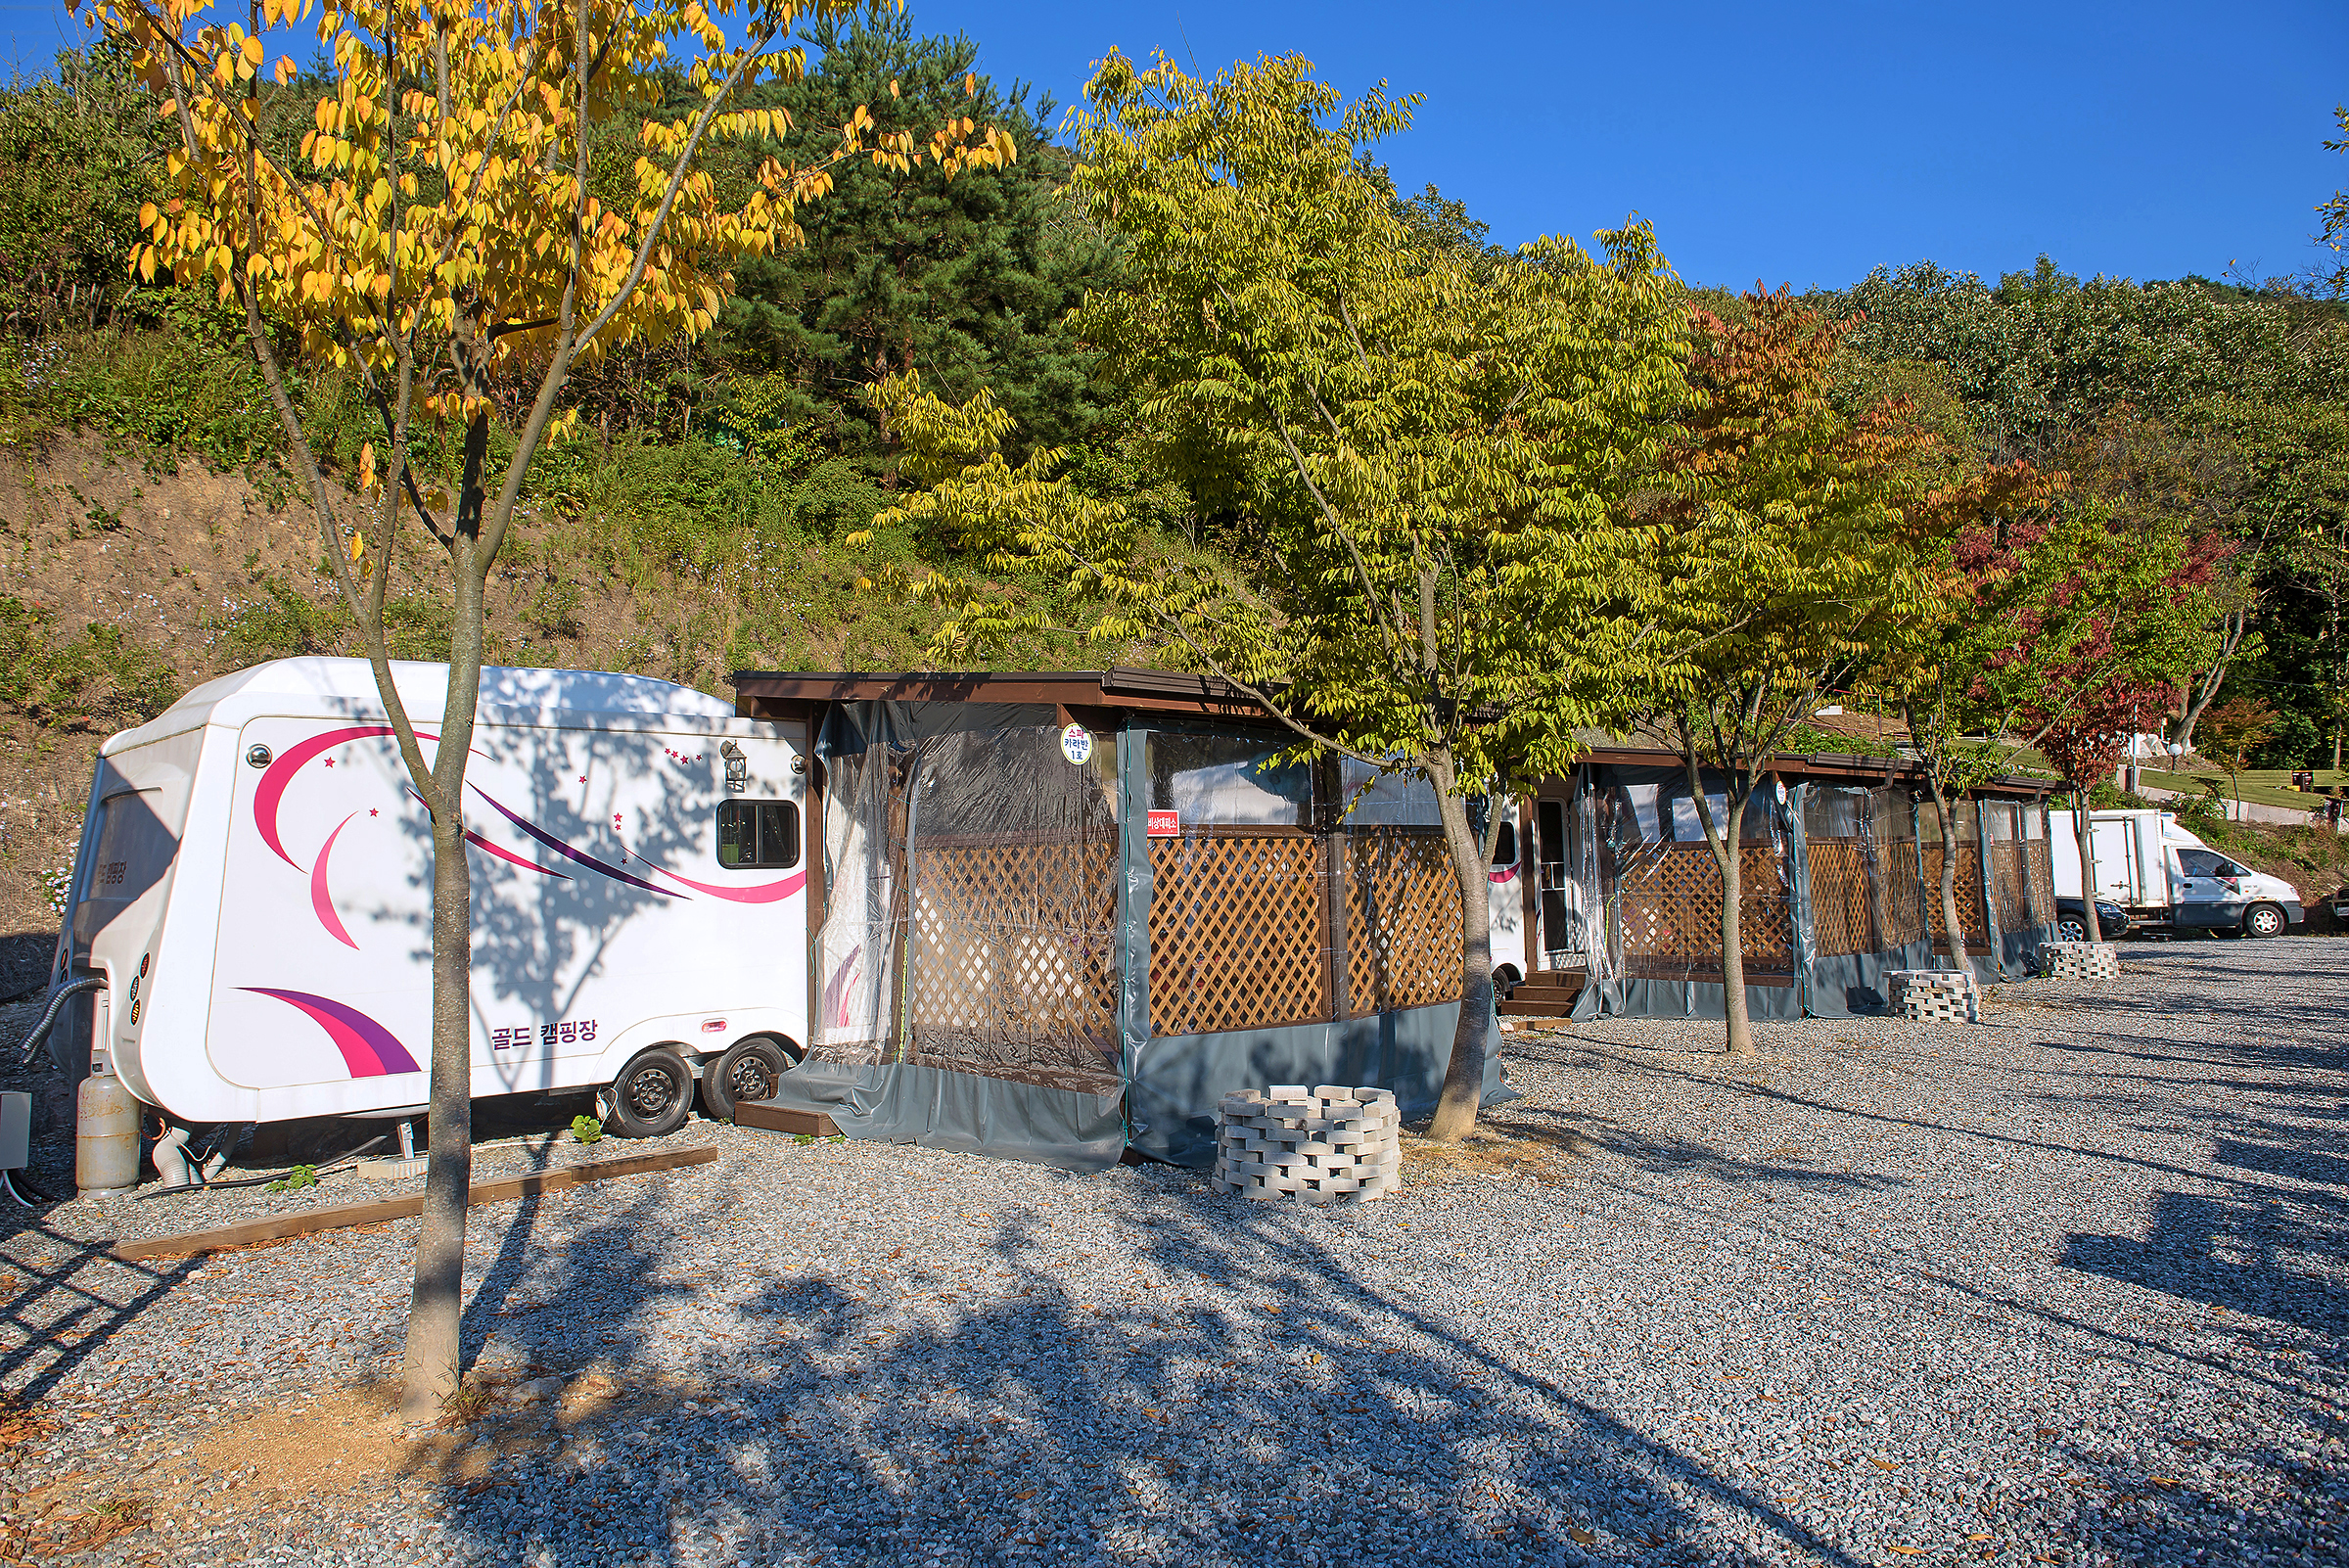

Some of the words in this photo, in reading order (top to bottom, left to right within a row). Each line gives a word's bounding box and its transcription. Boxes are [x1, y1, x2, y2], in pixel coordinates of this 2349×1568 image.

[1068, 728, 1084, 739] 스파
[1064, 738, 1088, 751] 카라반
[1071, 750, 1083, 761] 1호
[1148, 816, 1177, 829] 비상대피소
[491, 1027, 533, 1051] 골드
[540, 1019, 598, 1046] 캠핑장
